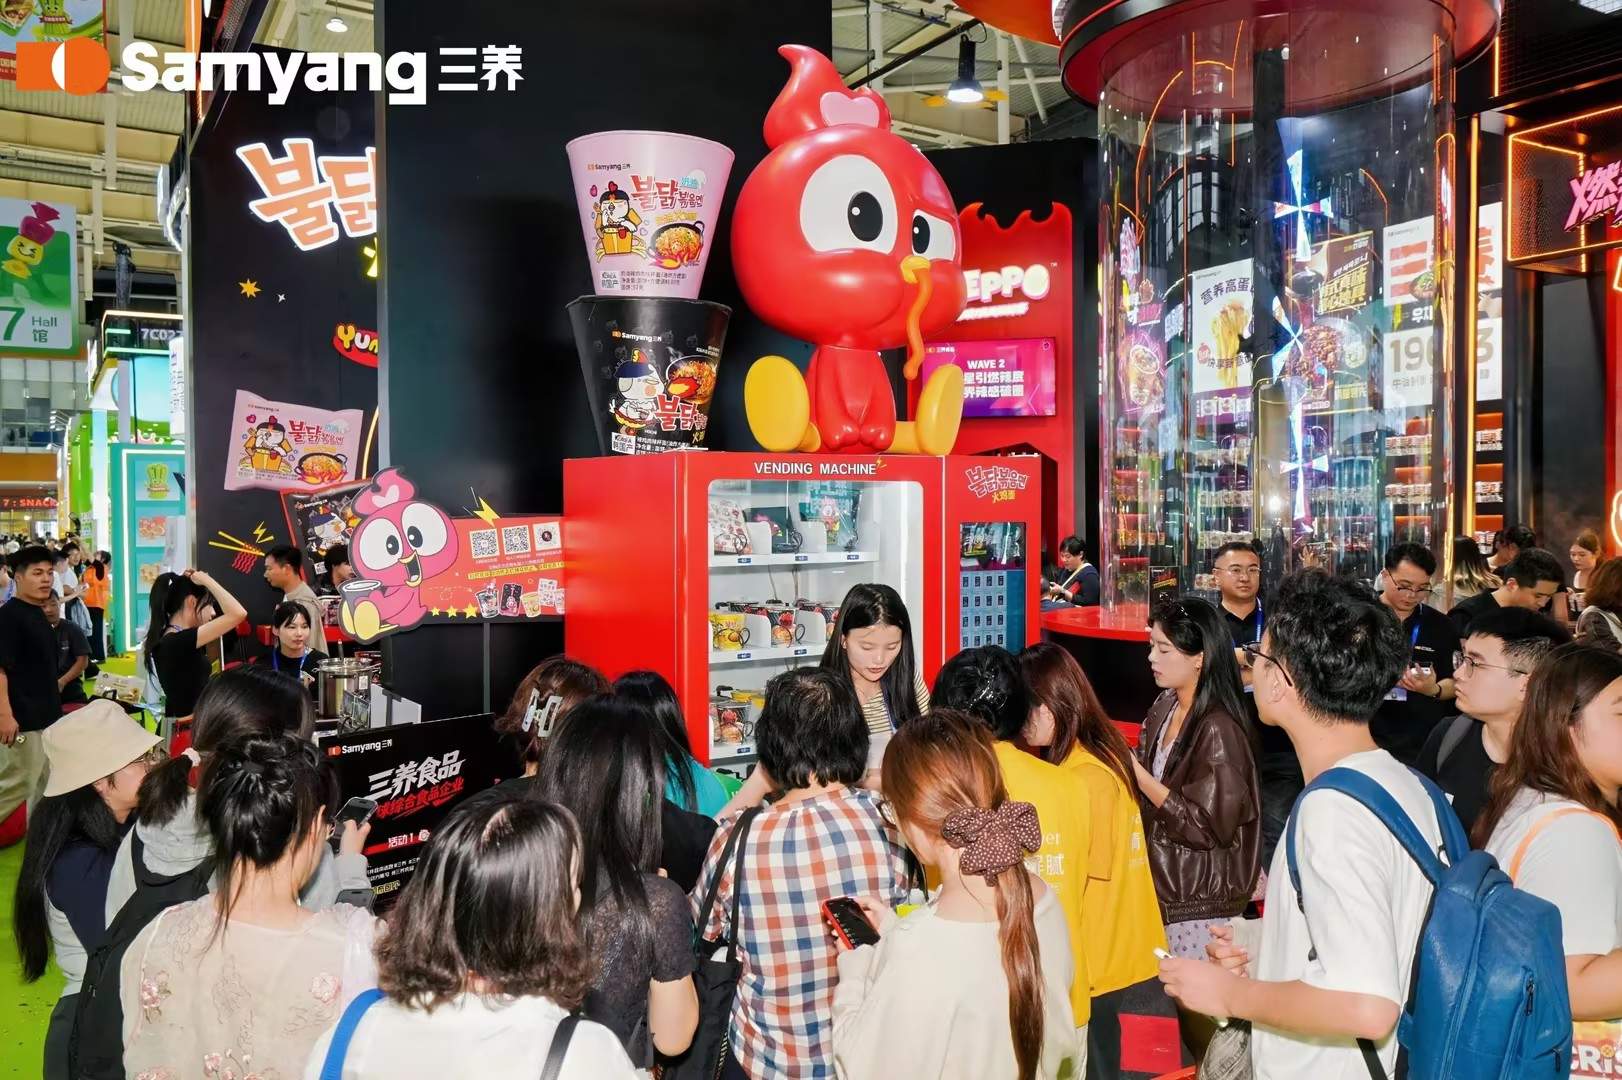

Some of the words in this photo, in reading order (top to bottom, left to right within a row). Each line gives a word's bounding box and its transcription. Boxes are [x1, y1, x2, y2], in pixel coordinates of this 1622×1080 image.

[1200, 277, 1254, 306] 营养高蛋
[0, 306, 25, 341] 7
[32, 316, 57, 327] Hall
[33, 329, 48, 343] 馆
[622, 332, 652, 342] Samyang
[967, 360, 997, 369] WAVE
[998, 359, 1005, 368] 2
[754, 462, 813, 475] VENDING
[819, 463, 877, 475] MACHINE
[342, 741, 381, 754] Samyang
[361, 750, 466, 801] 三养食品
